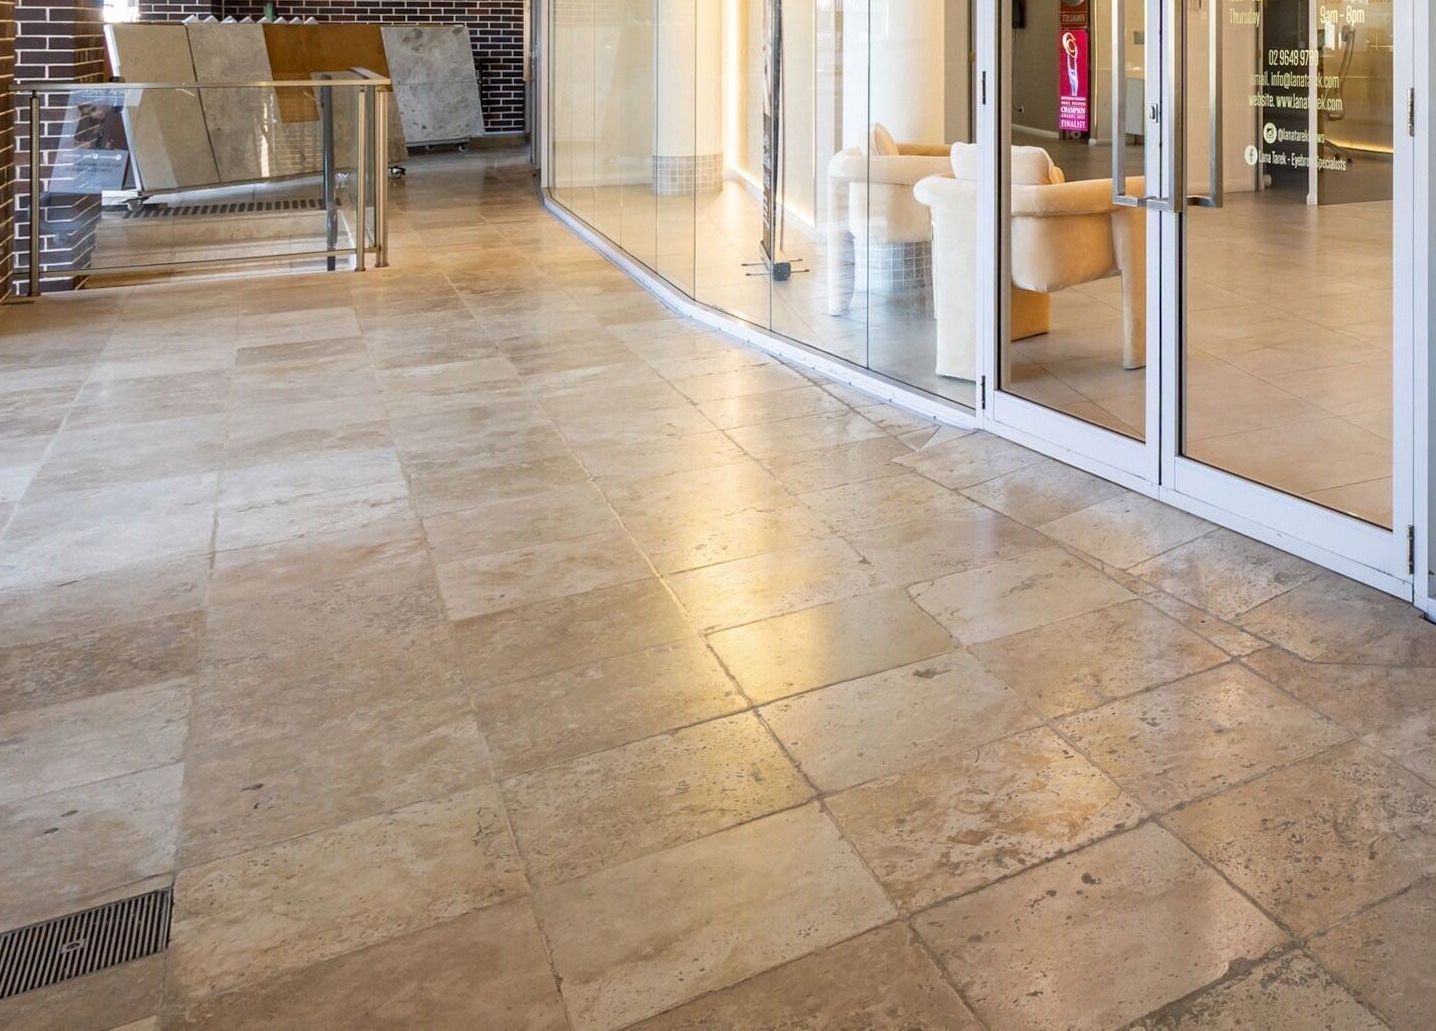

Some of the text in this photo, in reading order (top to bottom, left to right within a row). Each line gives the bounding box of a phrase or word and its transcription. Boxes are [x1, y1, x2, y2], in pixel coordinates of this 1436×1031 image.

[1228, 7, 1261, 28] Thursday
[1320, 5, 1338, 24] 9am
[1346, 5, 1365, 27] 8pm
[1268, 50, 1279, 66] 02
[1279, 50, 1299, 66] 9648
[1271, 70, 1340, 89] info@lanatak.com
[1276, 92, 1343, 111] www.lanaek.com
[1278, 128, 1325, 144] @lanatarekws
[1291, 152, 1314, 168] Eyebro
